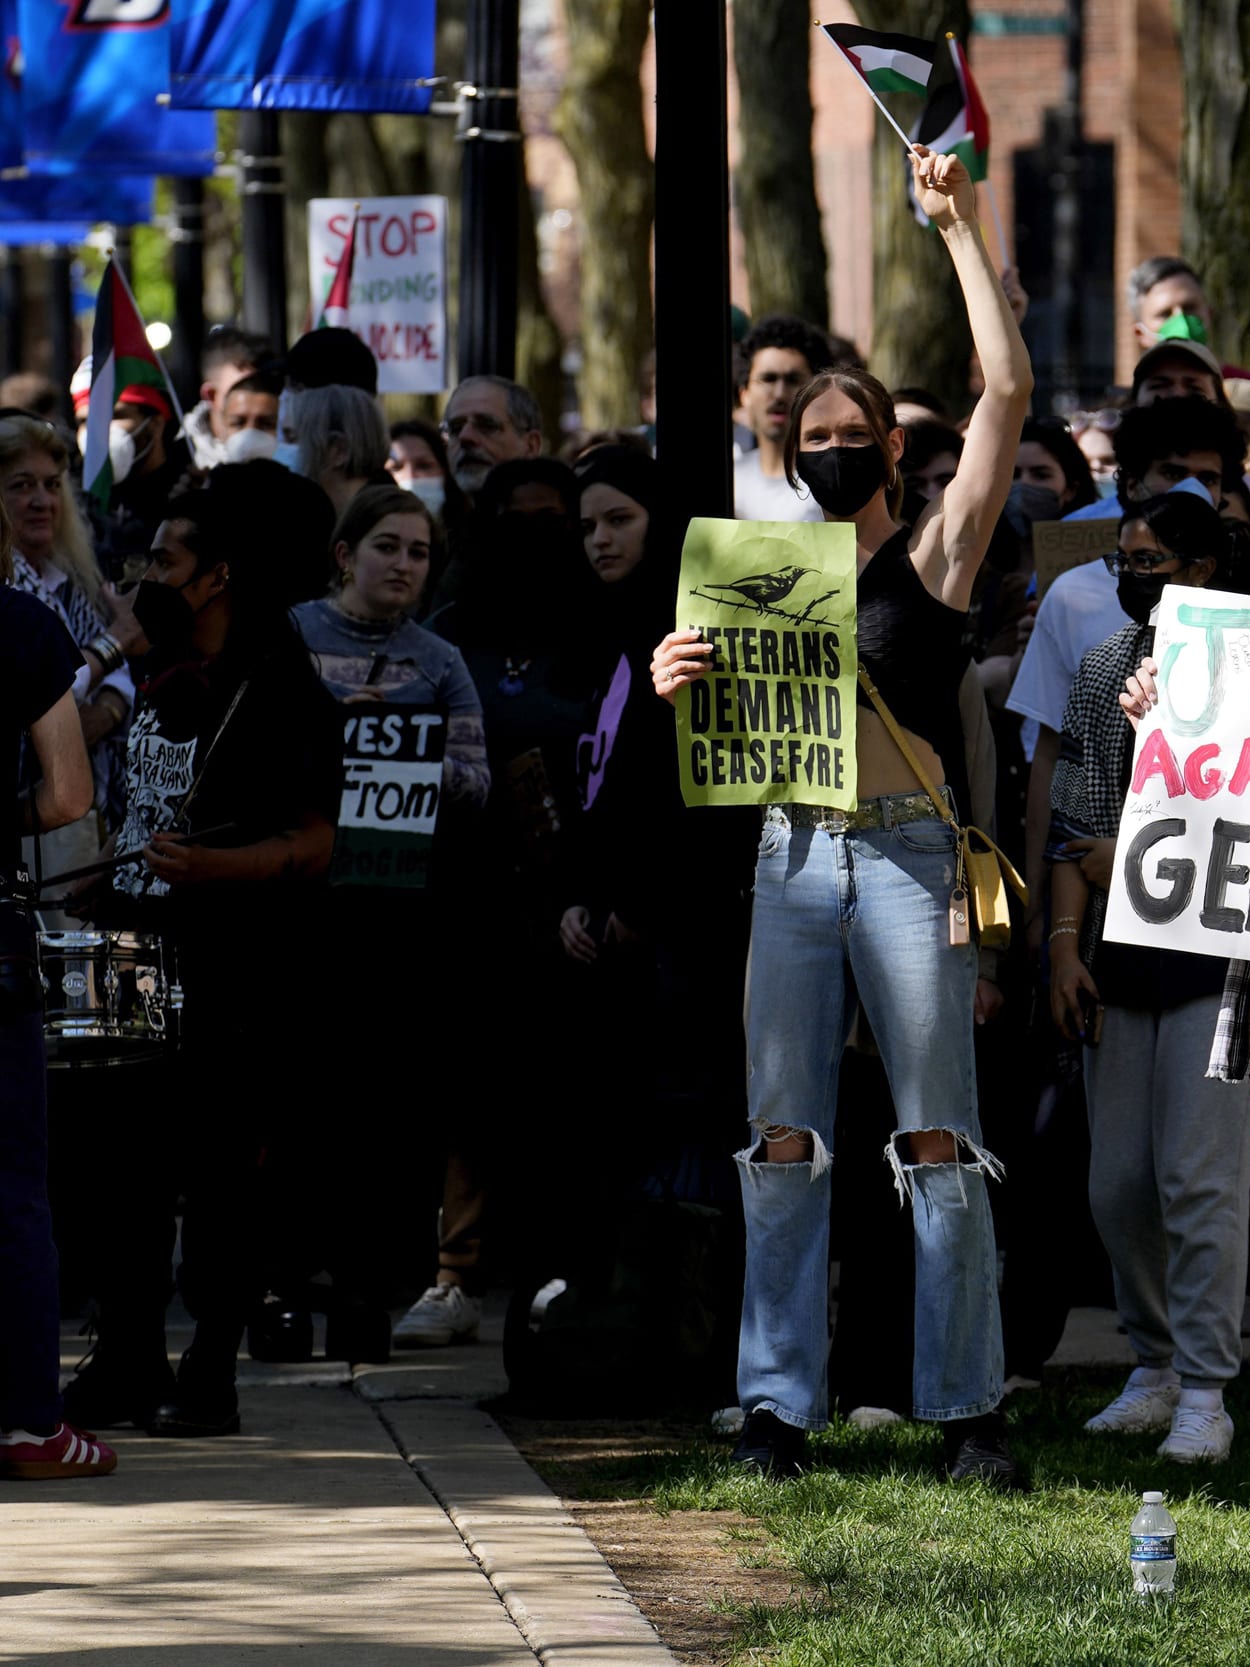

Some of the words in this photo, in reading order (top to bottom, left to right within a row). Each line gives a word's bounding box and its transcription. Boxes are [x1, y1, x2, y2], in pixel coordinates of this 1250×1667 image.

[324, 210, 437, 268] STOP
[689, 624, 840, 680] ETERANS
[690, 677, 842, 740] DEMAND
[690, 738, 844, 789] CEASEFIRE
